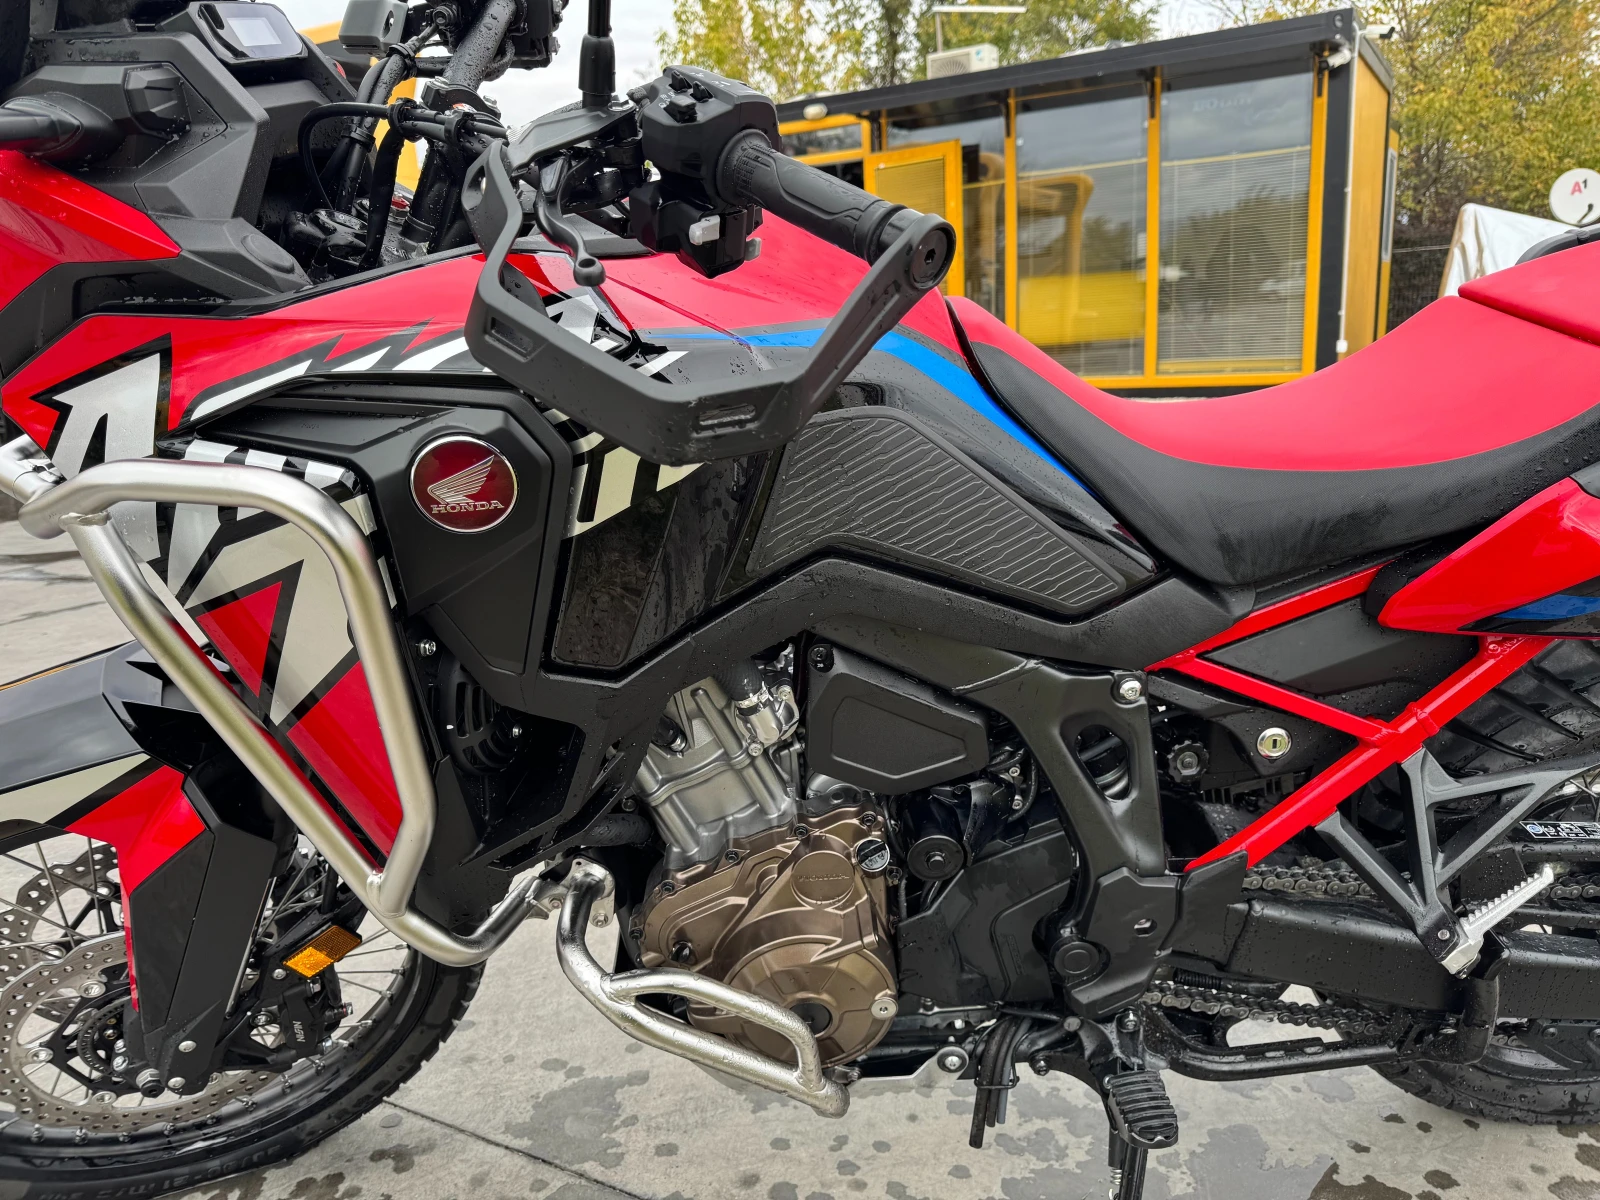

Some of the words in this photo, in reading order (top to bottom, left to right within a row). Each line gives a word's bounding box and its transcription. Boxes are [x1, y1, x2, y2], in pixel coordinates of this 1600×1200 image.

[1570, 178, 1588, 195] A1
[430, 500, 505, 514] HONDA
[292, 1020, 306, 1043] NISSIN
